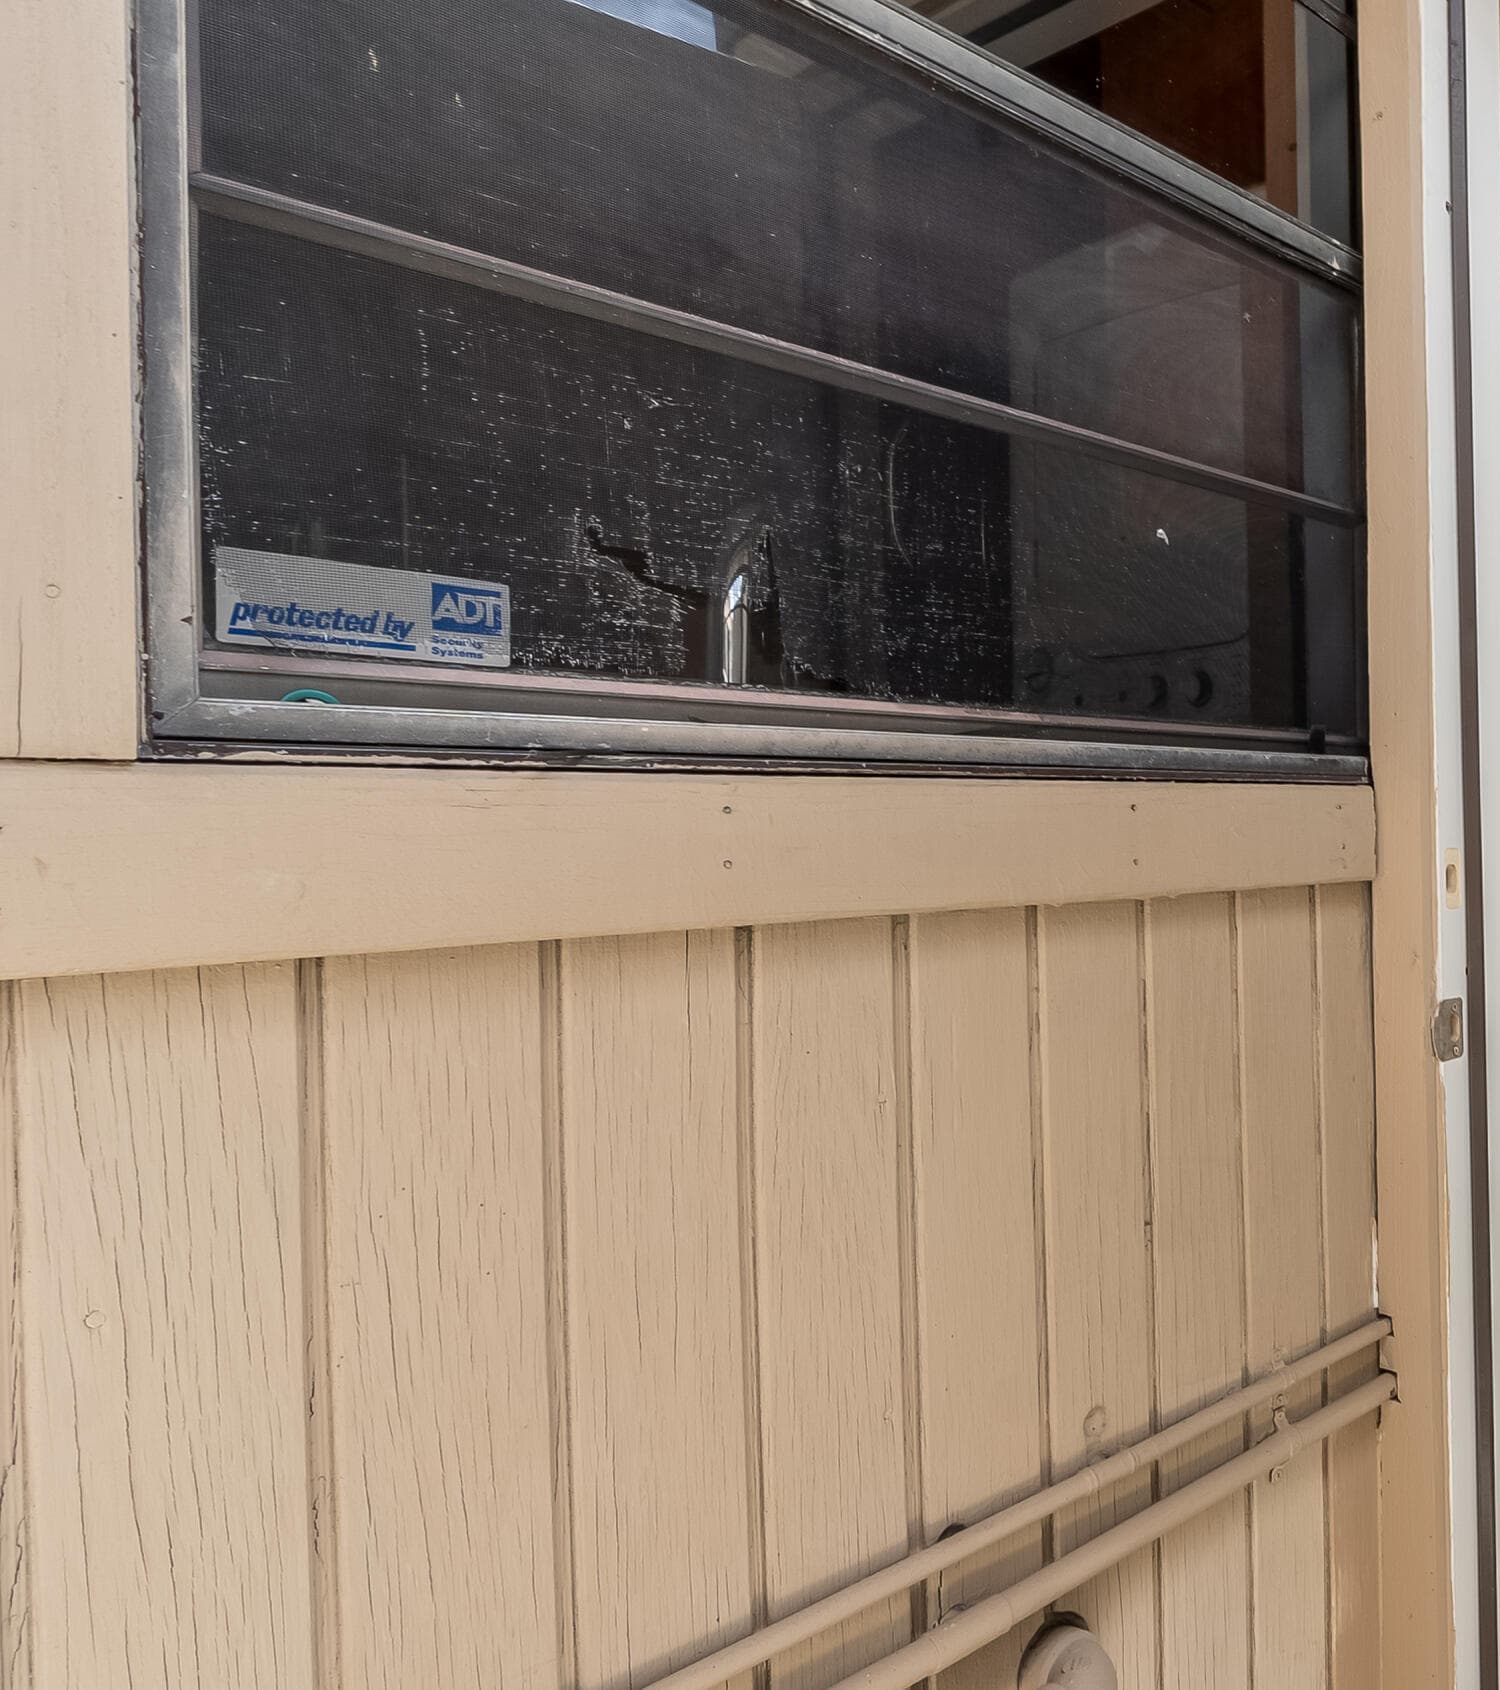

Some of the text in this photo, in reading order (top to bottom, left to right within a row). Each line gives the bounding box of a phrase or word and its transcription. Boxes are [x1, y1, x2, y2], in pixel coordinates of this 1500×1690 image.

[230, 600, 415, 642] protected by
[432, 591, 502, 630] ADT
[432, 646, 484, 660] Systems
